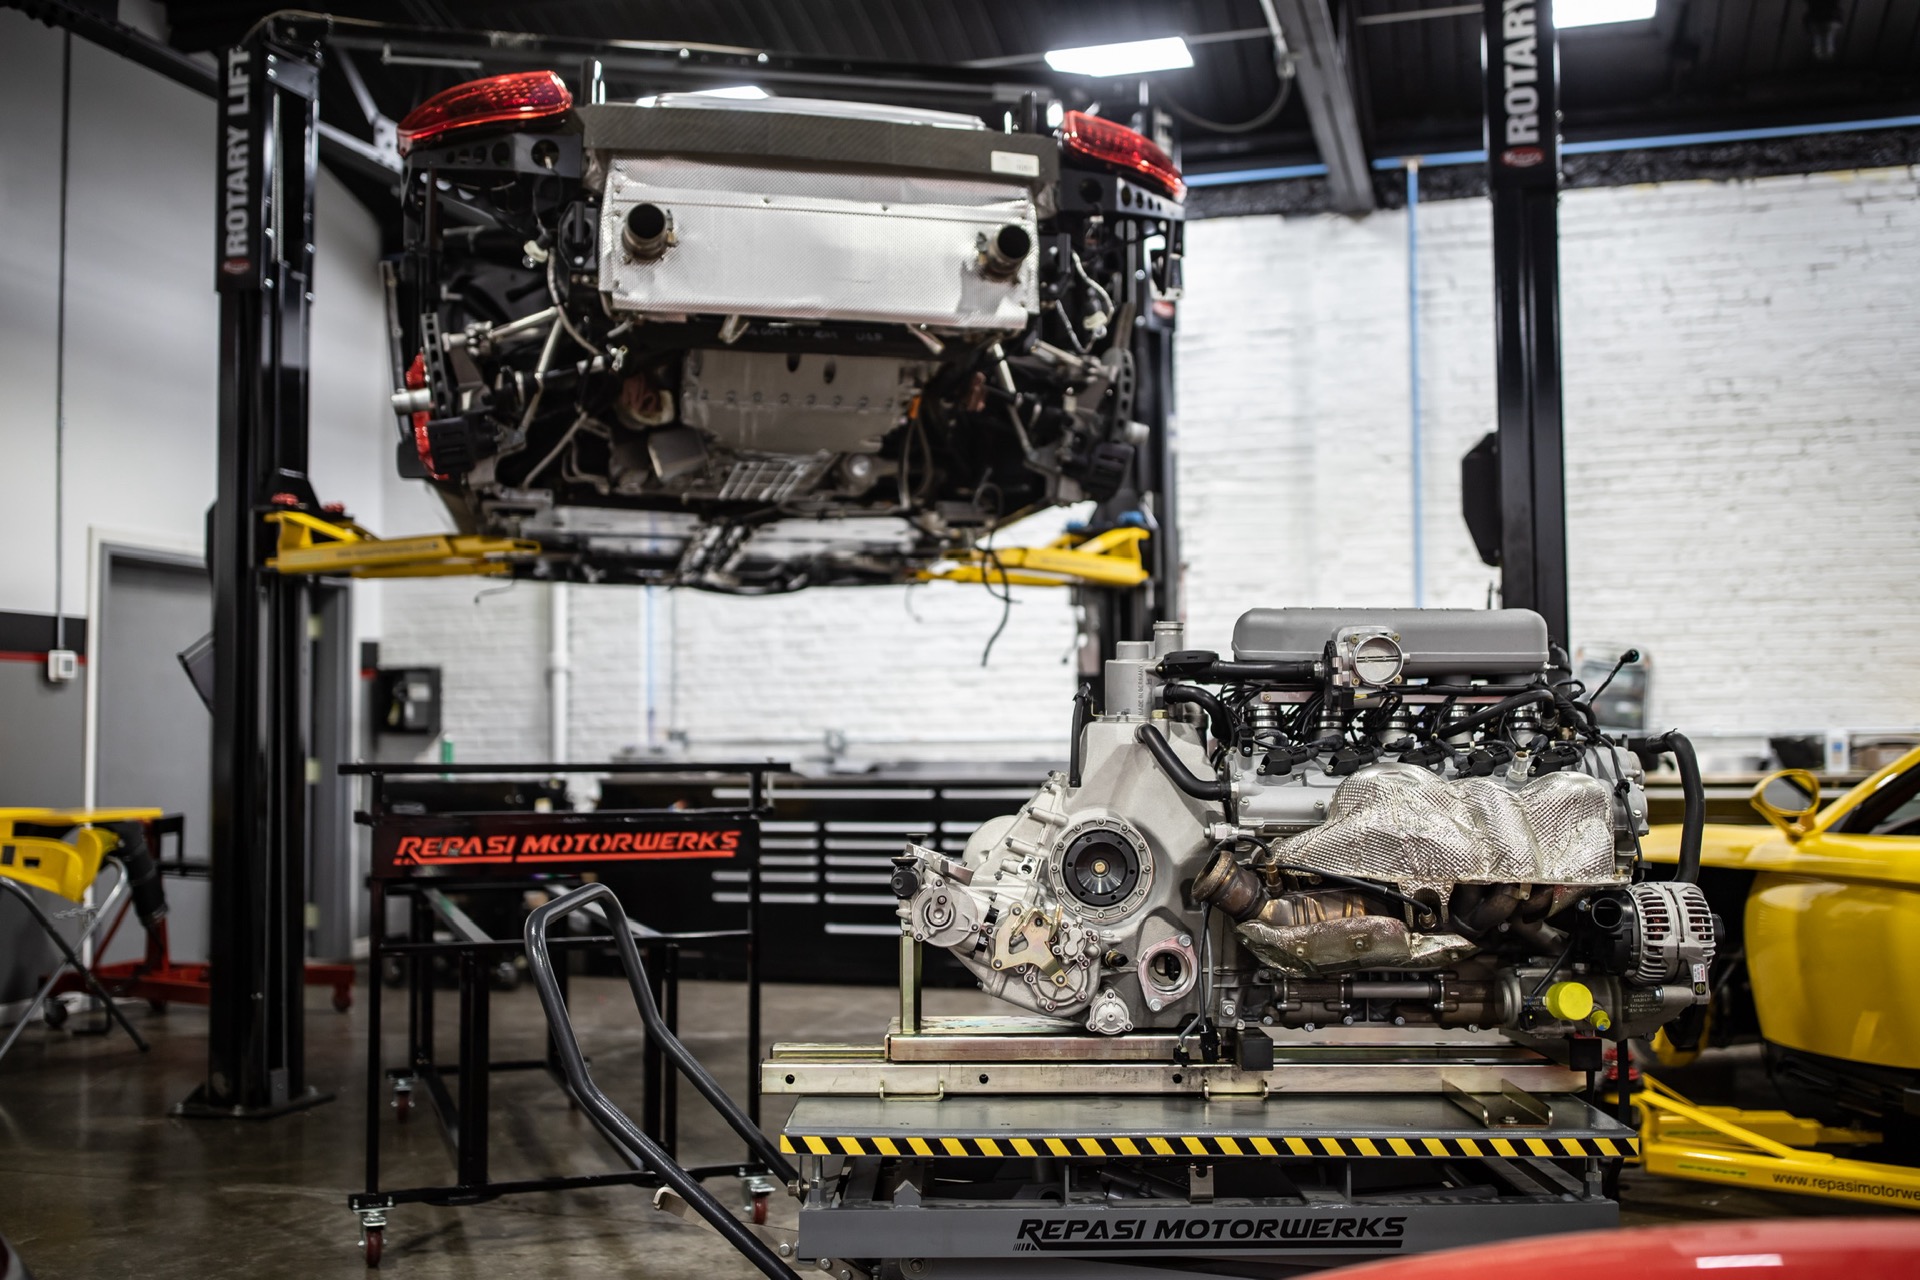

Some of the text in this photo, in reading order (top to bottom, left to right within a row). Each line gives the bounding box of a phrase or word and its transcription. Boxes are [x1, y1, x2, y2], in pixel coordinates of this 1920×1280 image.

[228, 48, 250, 116] LIFT
[226, 126, 249, 257] ROTARY
[396, 831, 742, 858] REPASI MOTORWERKS
[1017, 1216, 1408, 1240] REPASI MOTORWERKS
